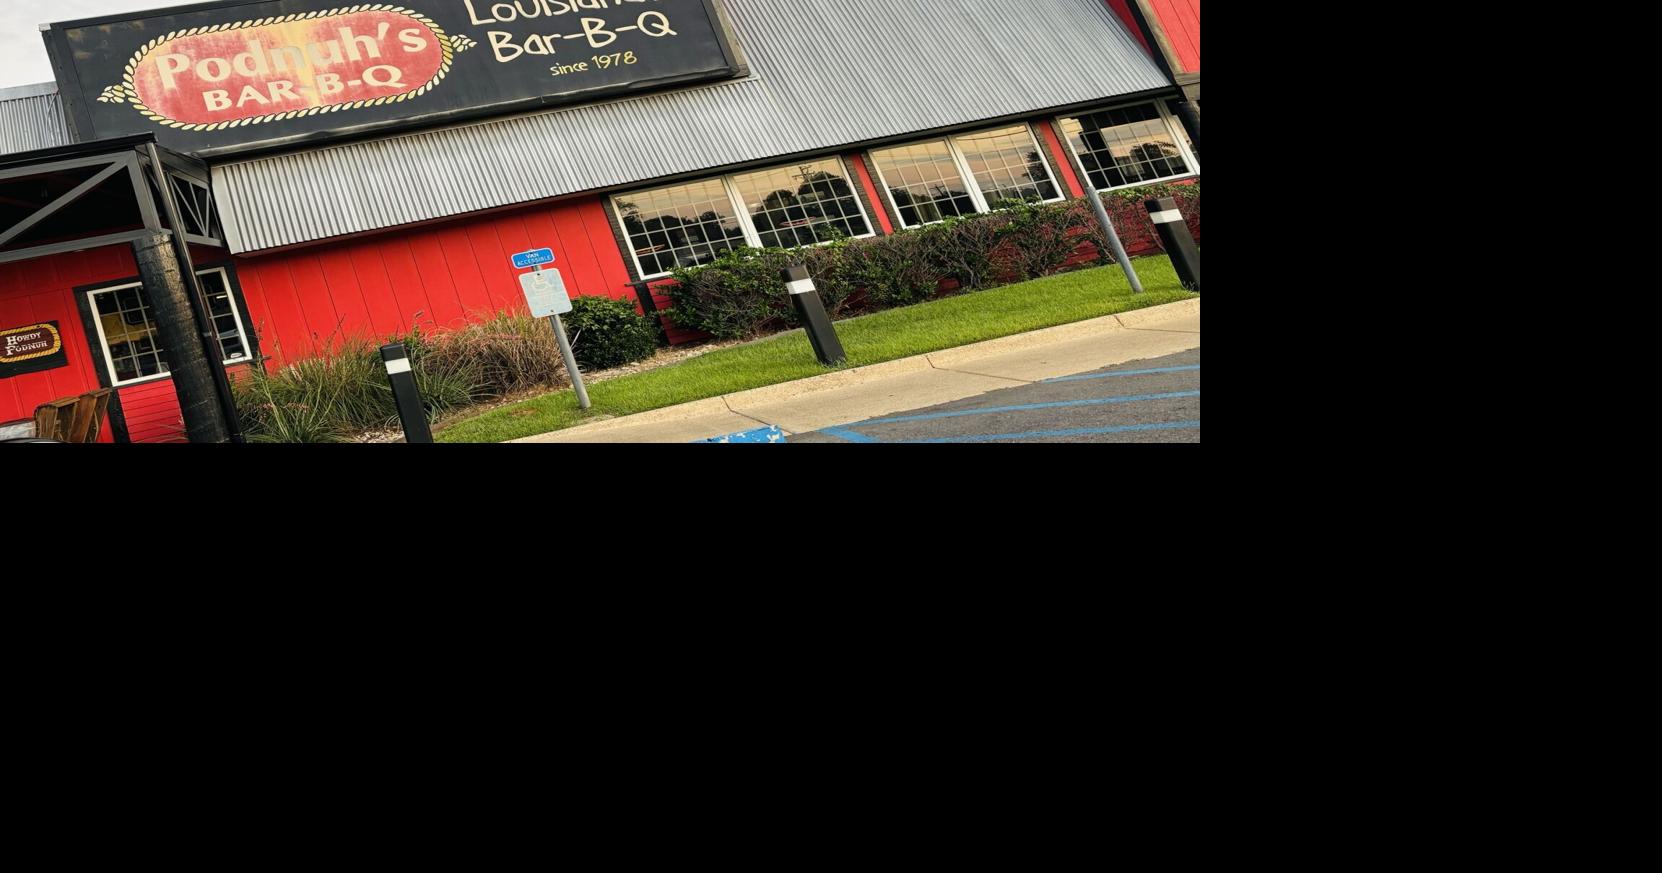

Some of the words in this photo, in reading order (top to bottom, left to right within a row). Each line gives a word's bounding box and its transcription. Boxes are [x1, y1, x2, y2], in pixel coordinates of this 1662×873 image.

[464, 0, 658, 25] Louisi
[155, 22, 427, 90] Podnuh's
[487, 11, 677, 62] Bar-B-Q
[550, 61, 588, 76] since
[592, 51, 637, 69] 1978
[202, 64, 407, 111] BAR-B-Q
